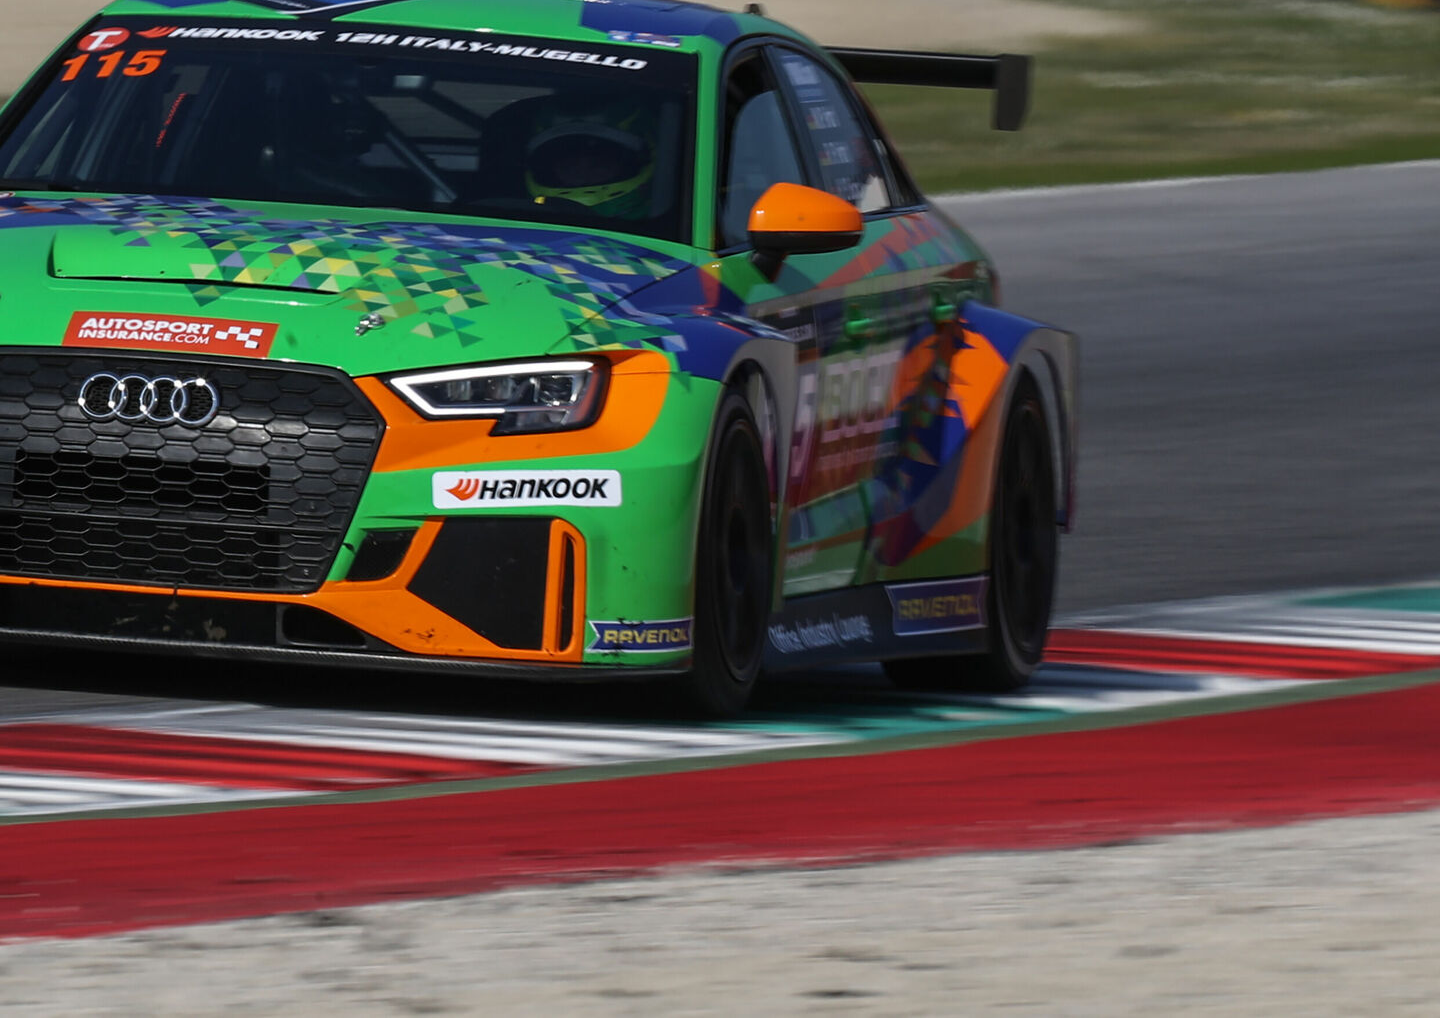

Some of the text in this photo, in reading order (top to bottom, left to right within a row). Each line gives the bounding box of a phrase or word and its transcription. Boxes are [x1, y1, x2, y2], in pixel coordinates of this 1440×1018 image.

[334, 31, 400, 46] 12H
[397, 35, 649, 71] ITALY-MUGELLO
[60, 49, 168, 82] 115
[80, 317, 214, 335] AUTOSPORT
[77, 329, 210, 345] INSURANCE.COM
[603, 627, 689, 645] RAVENOL
